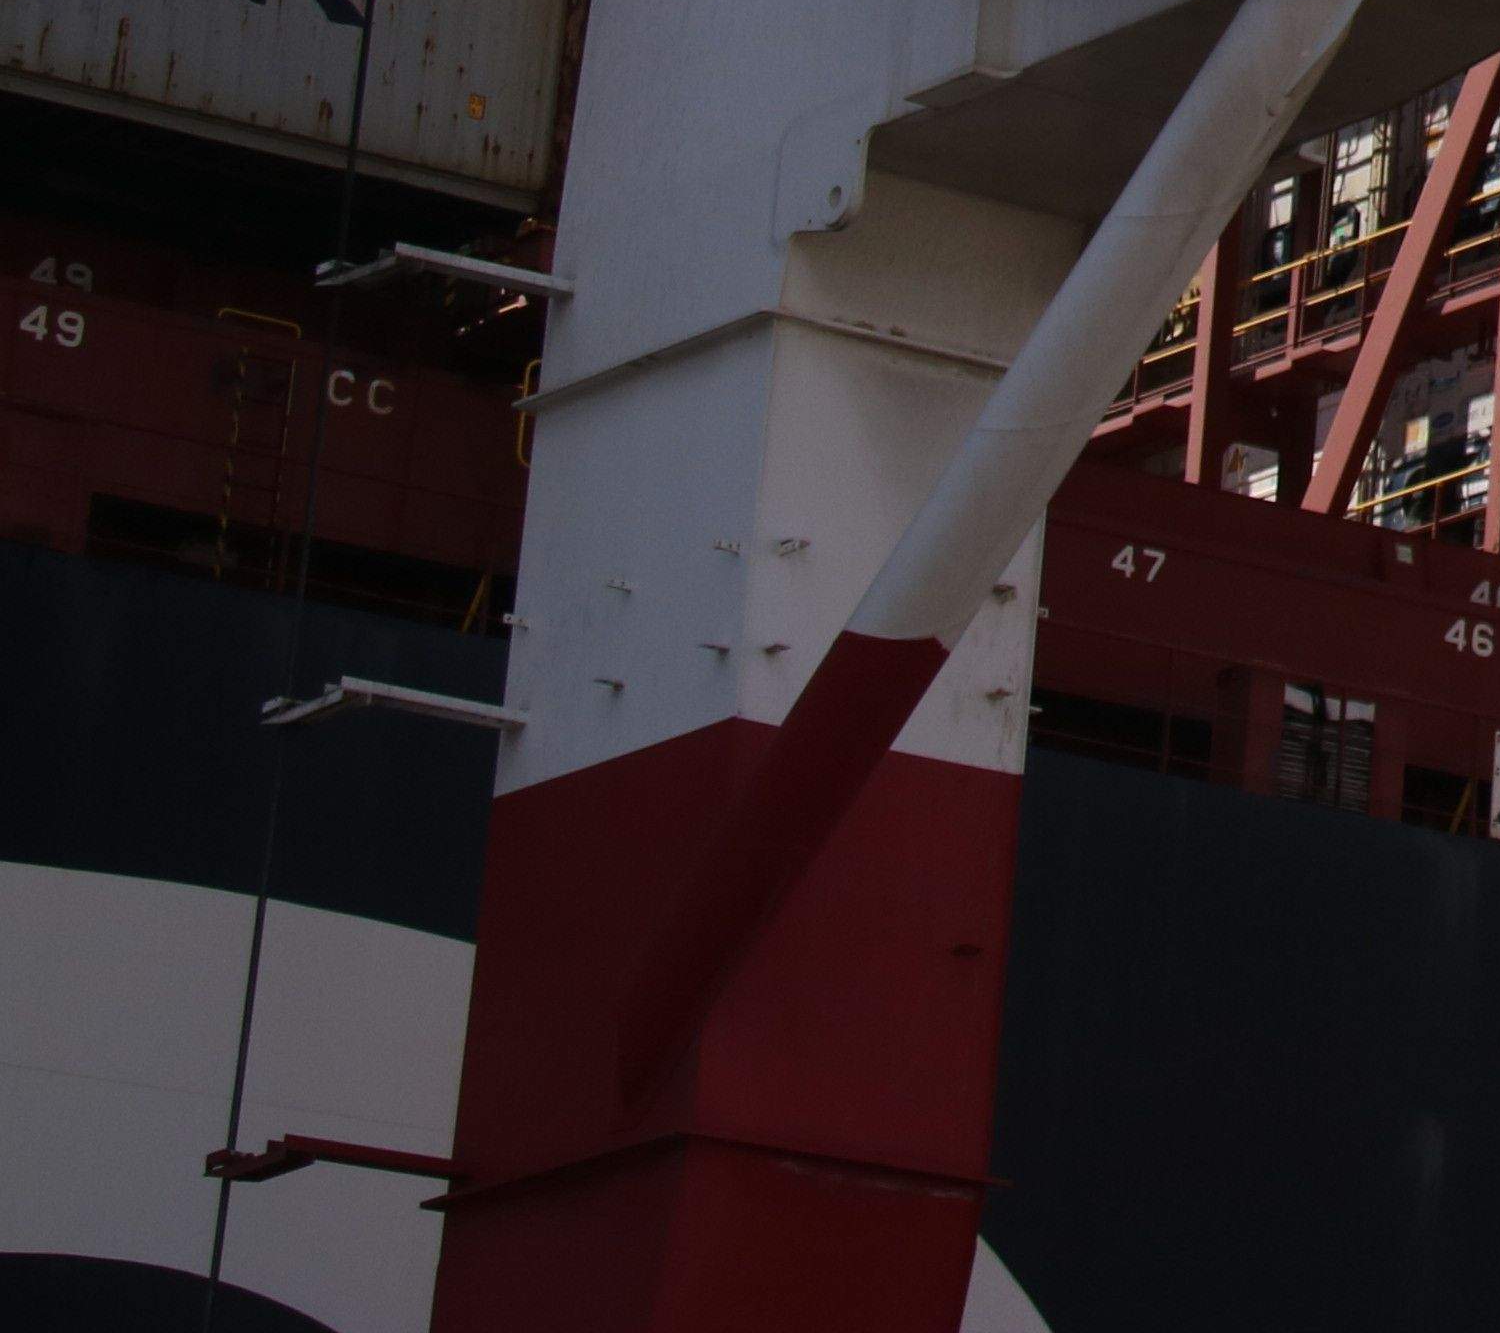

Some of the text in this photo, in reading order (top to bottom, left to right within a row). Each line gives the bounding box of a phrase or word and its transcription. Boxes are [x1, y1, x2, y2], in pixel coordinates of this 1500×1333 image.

[29, 256, 95, 295] 49
[18, 303, 88, 350] 49
[327, 369, 396, 417] CC
[1110, 544, 1168, 585] 47
[1443, 615, 1497, 659] 46
